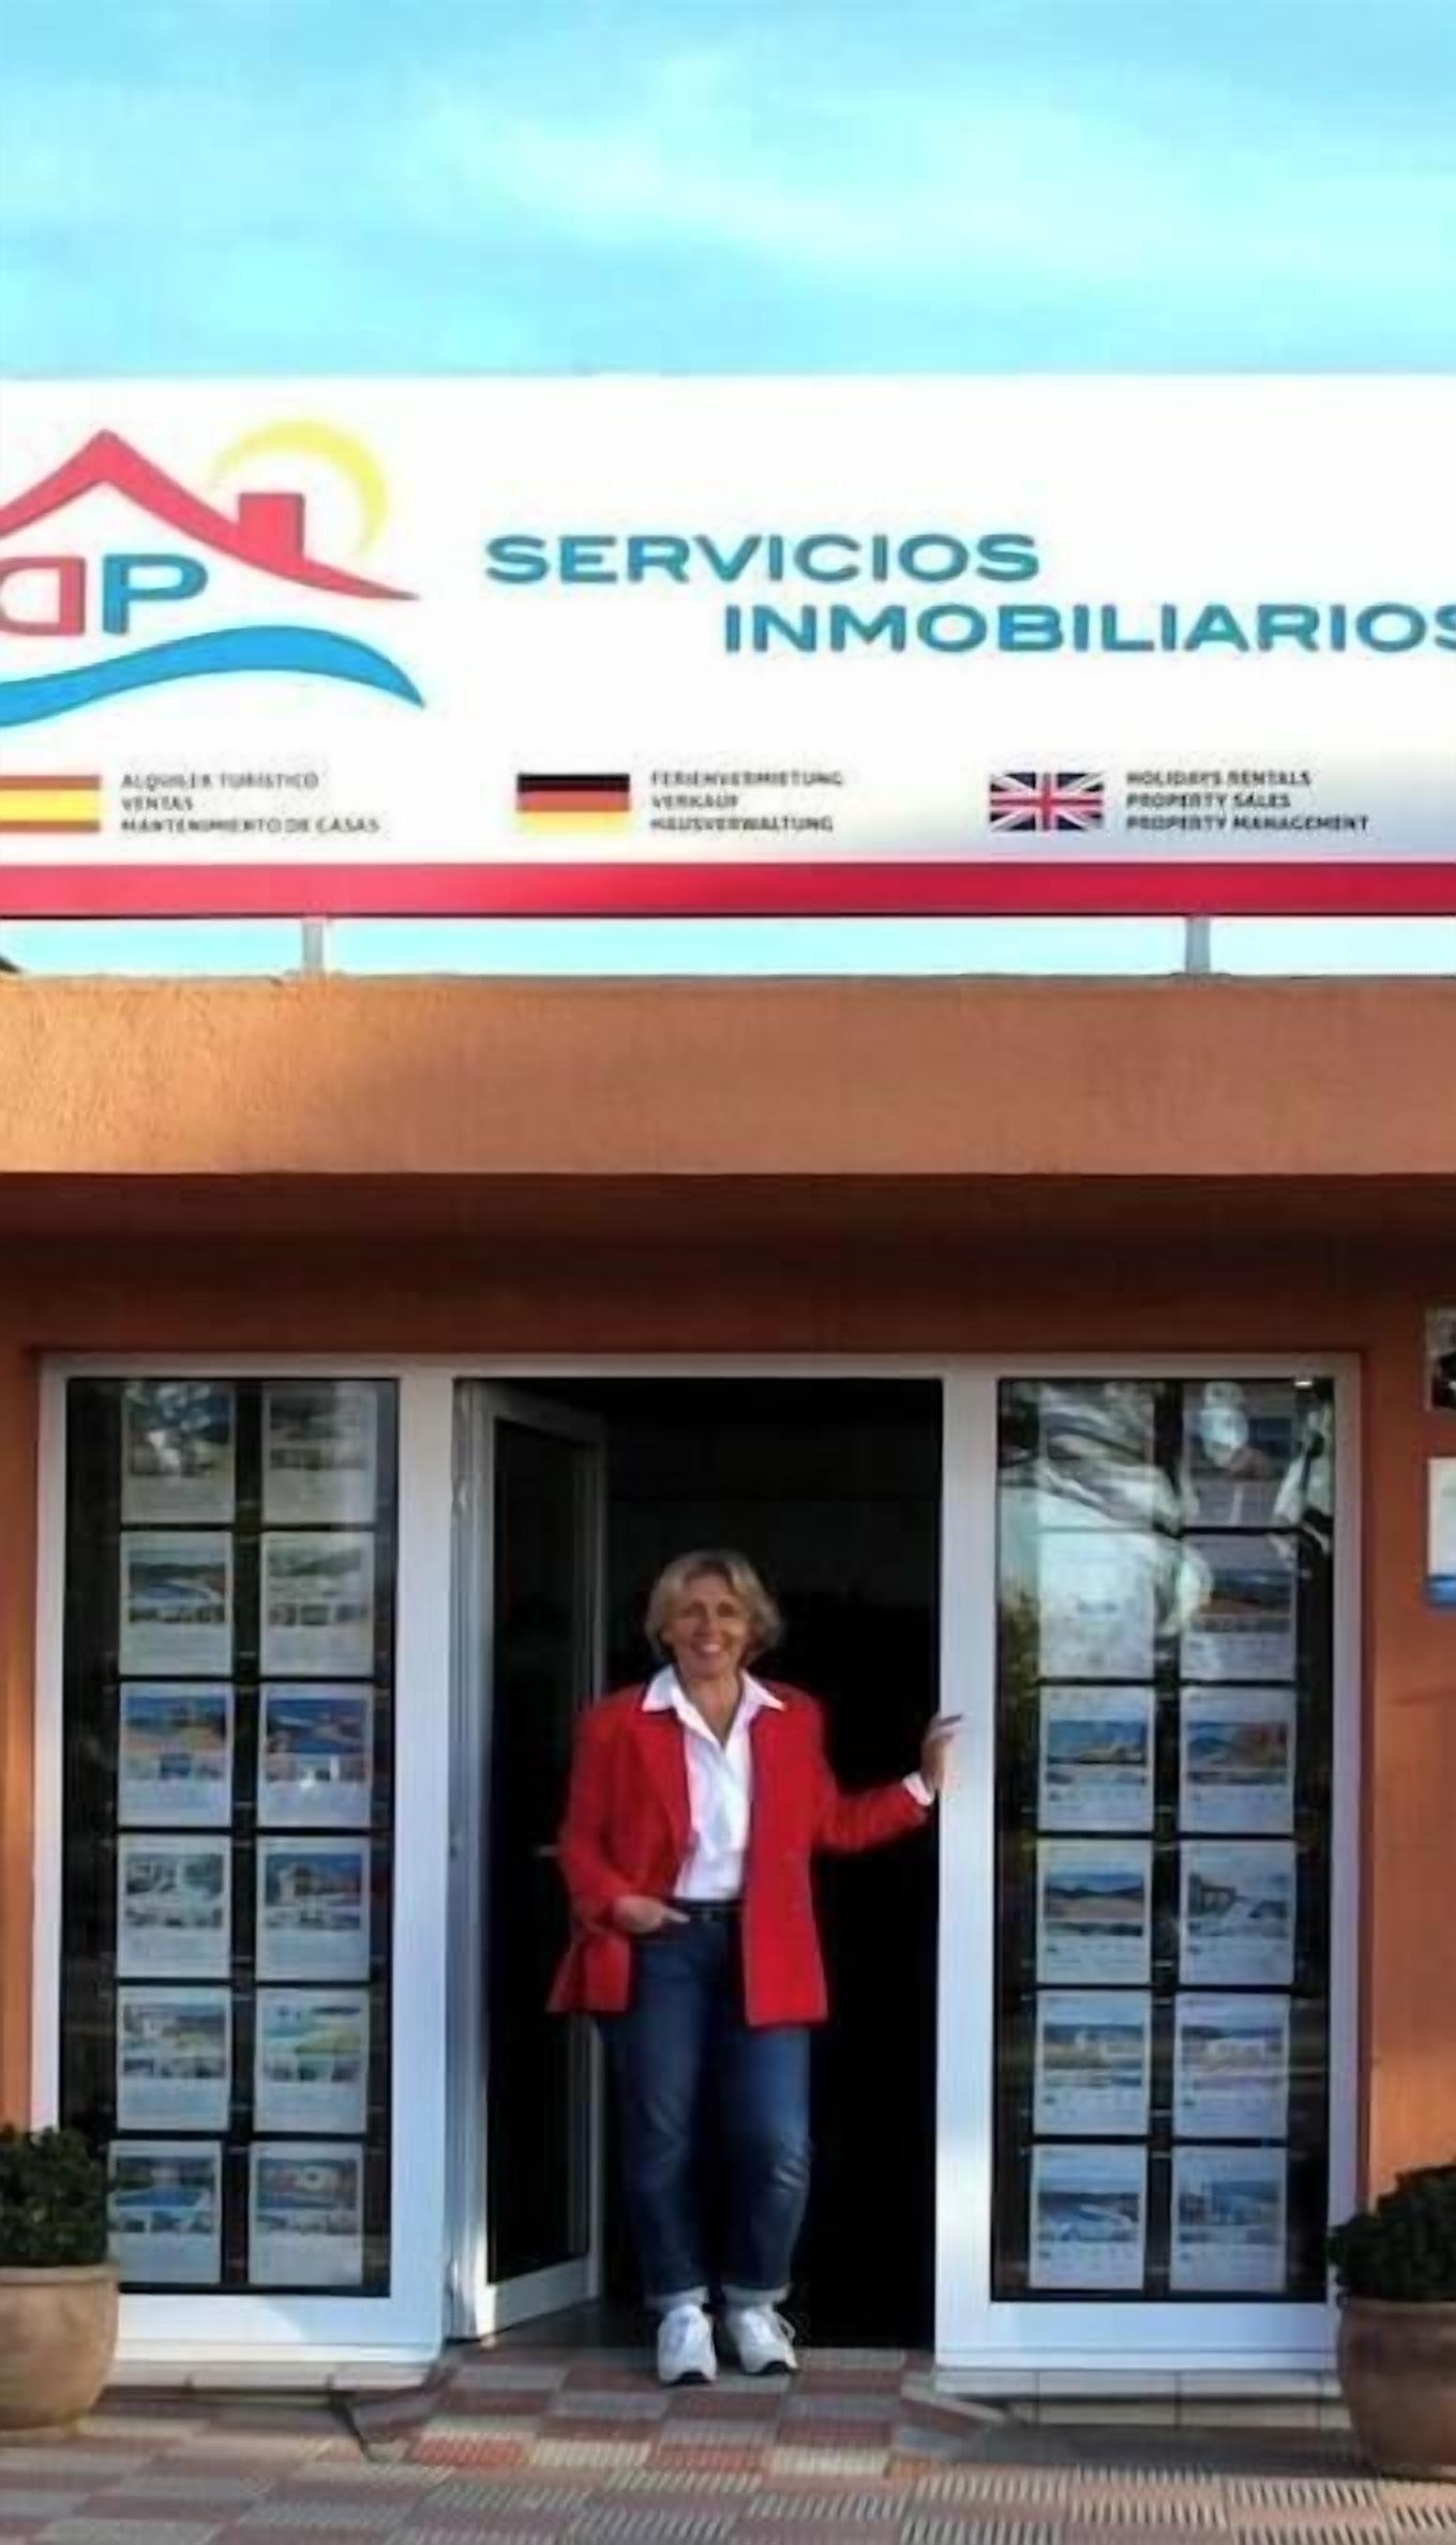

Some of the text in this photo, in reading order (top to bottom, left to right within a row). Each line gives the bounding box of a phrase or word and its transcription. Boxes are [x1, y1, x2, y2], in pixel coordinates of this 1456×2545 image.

[486, 533, 1039, 585] SERVICIOS
[121, 796, 193, 811] VENTAS
[1127, 793, 1291, 809] PROPERTY SALES
[284, 818, 310, 833] DE
[315, 817, 380, 833] CASAS
[1127, 815, 1228, 831] PROPERTY
